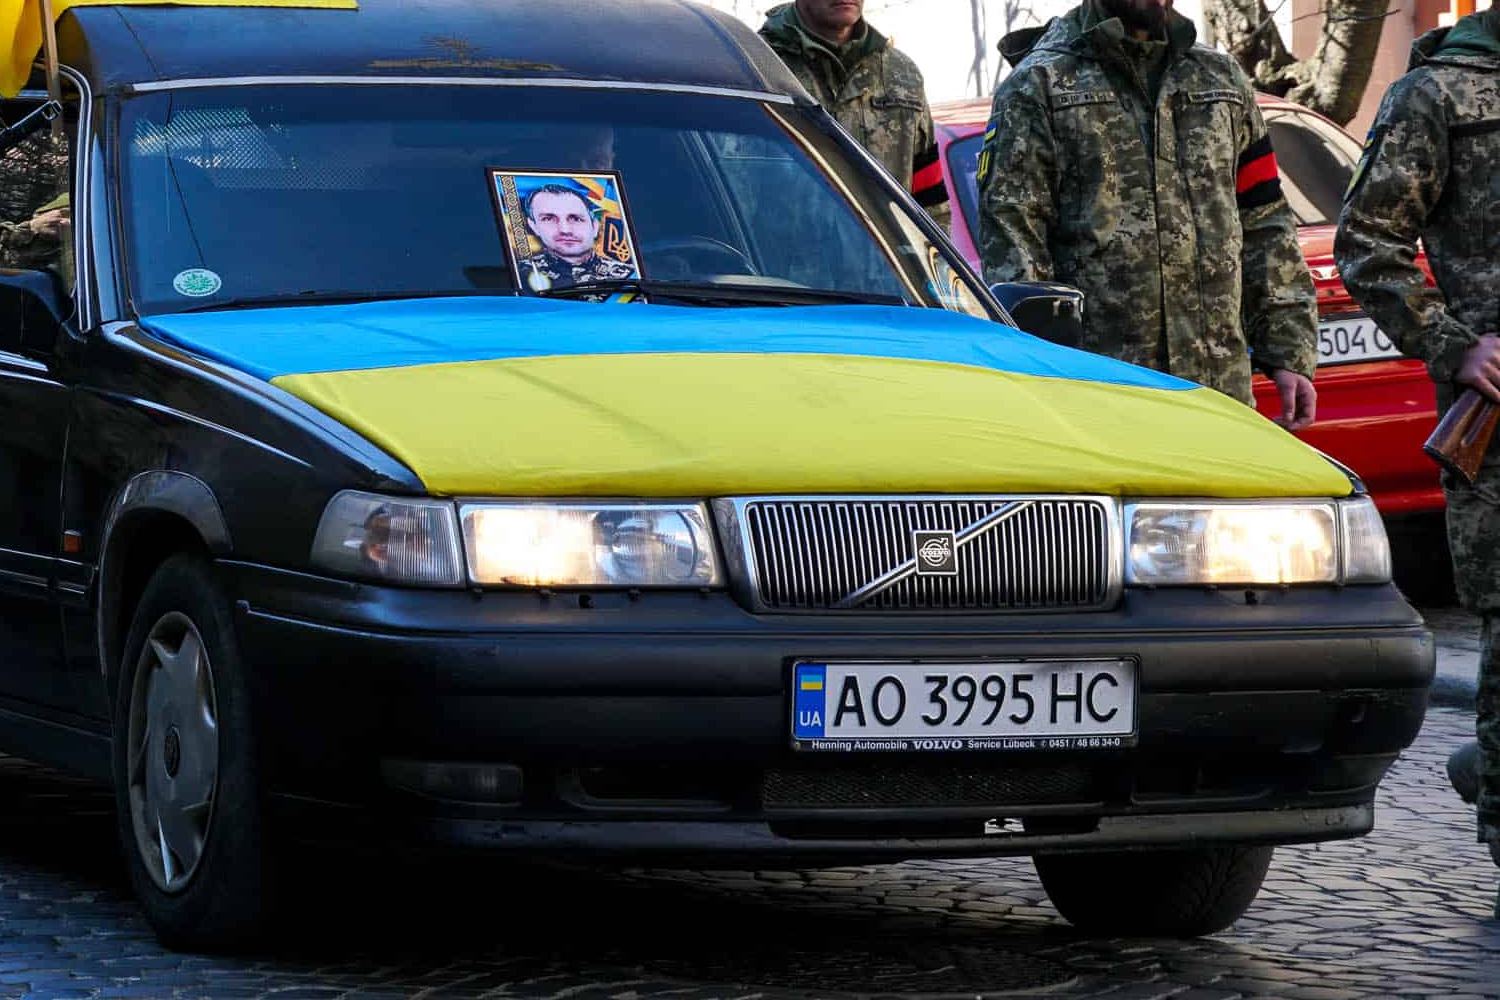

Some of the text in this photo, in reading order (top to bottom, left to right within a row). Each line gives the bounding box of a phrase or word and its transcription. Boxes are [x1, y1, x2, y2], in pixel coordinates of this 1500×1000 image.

[1316, 325, 1367, 357] 504
[833, 671, 1119, 727] AO 3995 HC
[799, 711, 822, 728] UA
[811, 740, 852, 752] Henning
[854, 740, 908, 750] Automobile
[913, 739, 963, 750] VOLVO
[968, 738, 1001, 749] Service
